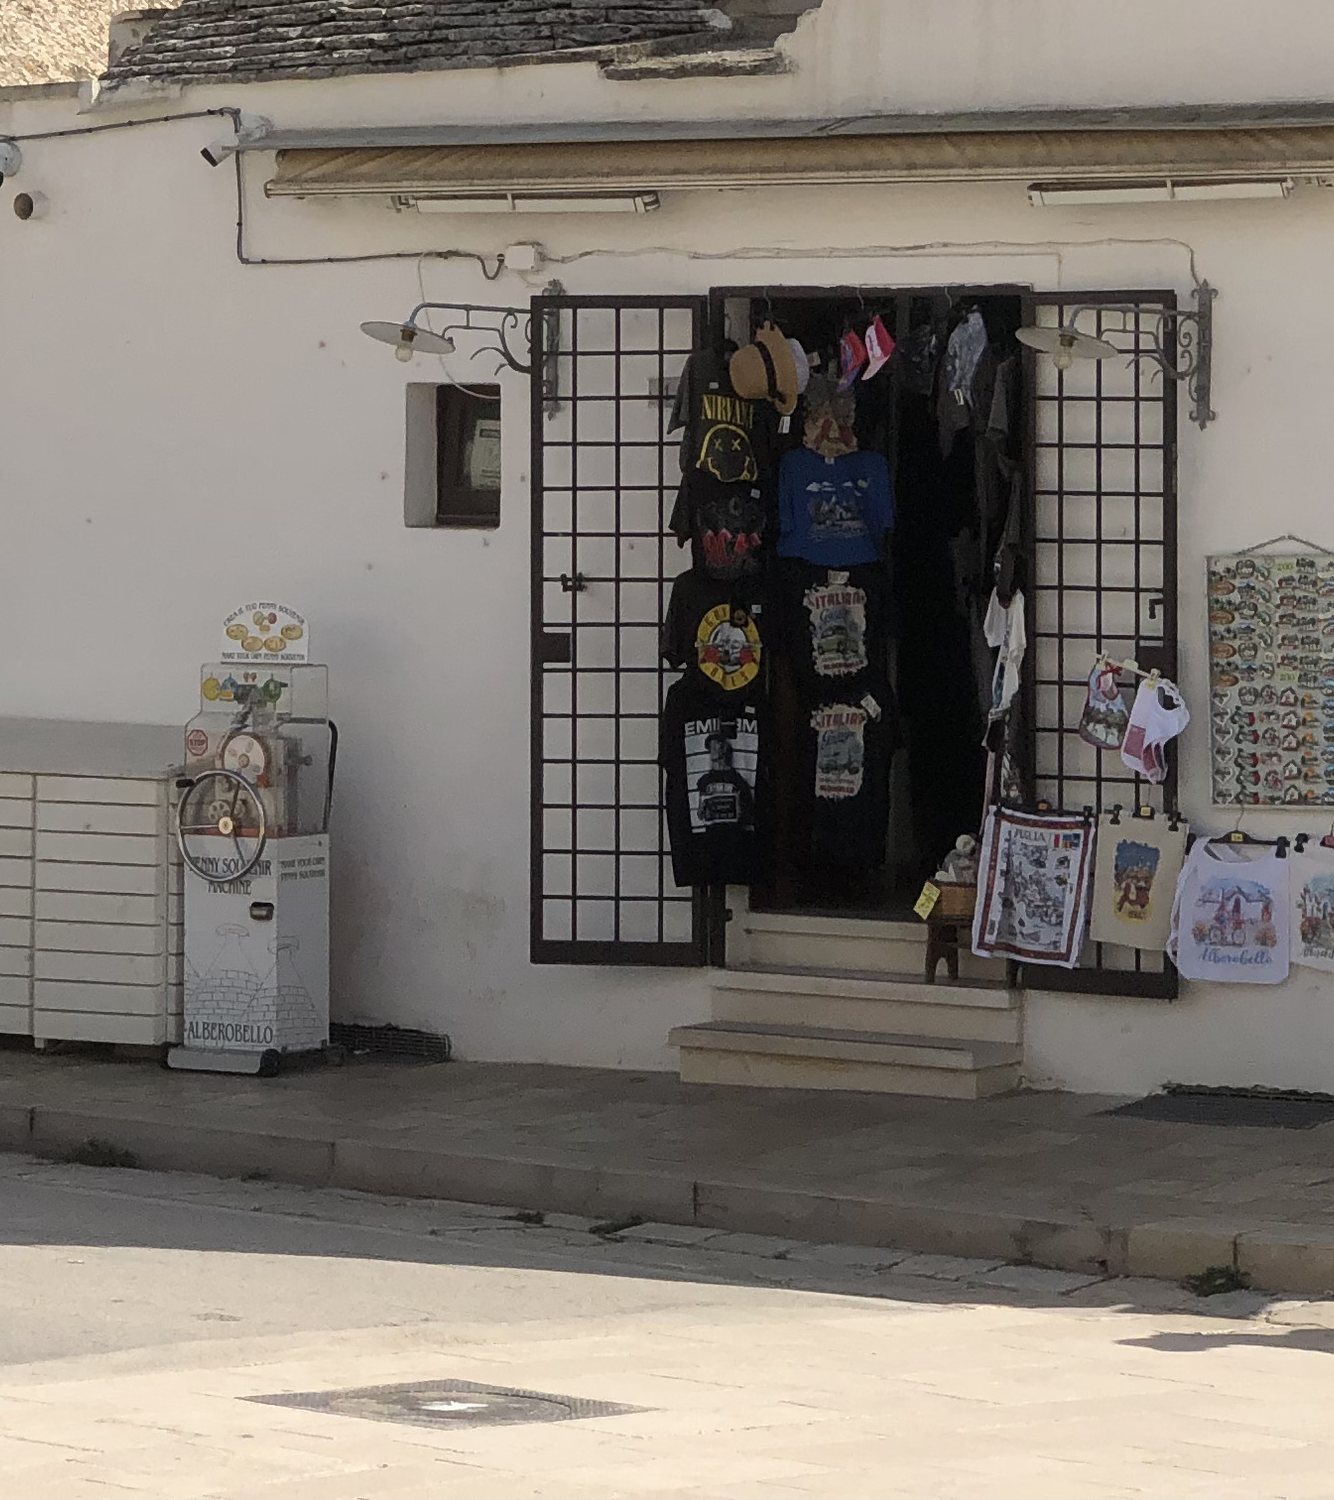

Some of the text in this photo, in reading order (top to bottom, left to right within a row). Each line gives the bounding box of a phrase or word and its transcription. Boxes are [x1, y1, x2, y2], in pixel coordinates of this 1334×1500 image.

[189, 739, 207, 747] STOP
[222, 857, 272, 876] SOUENIR
[208, 880, 252, 896] MACHINE
[188, 1021, 274, 1045] ALBEROBELLO
